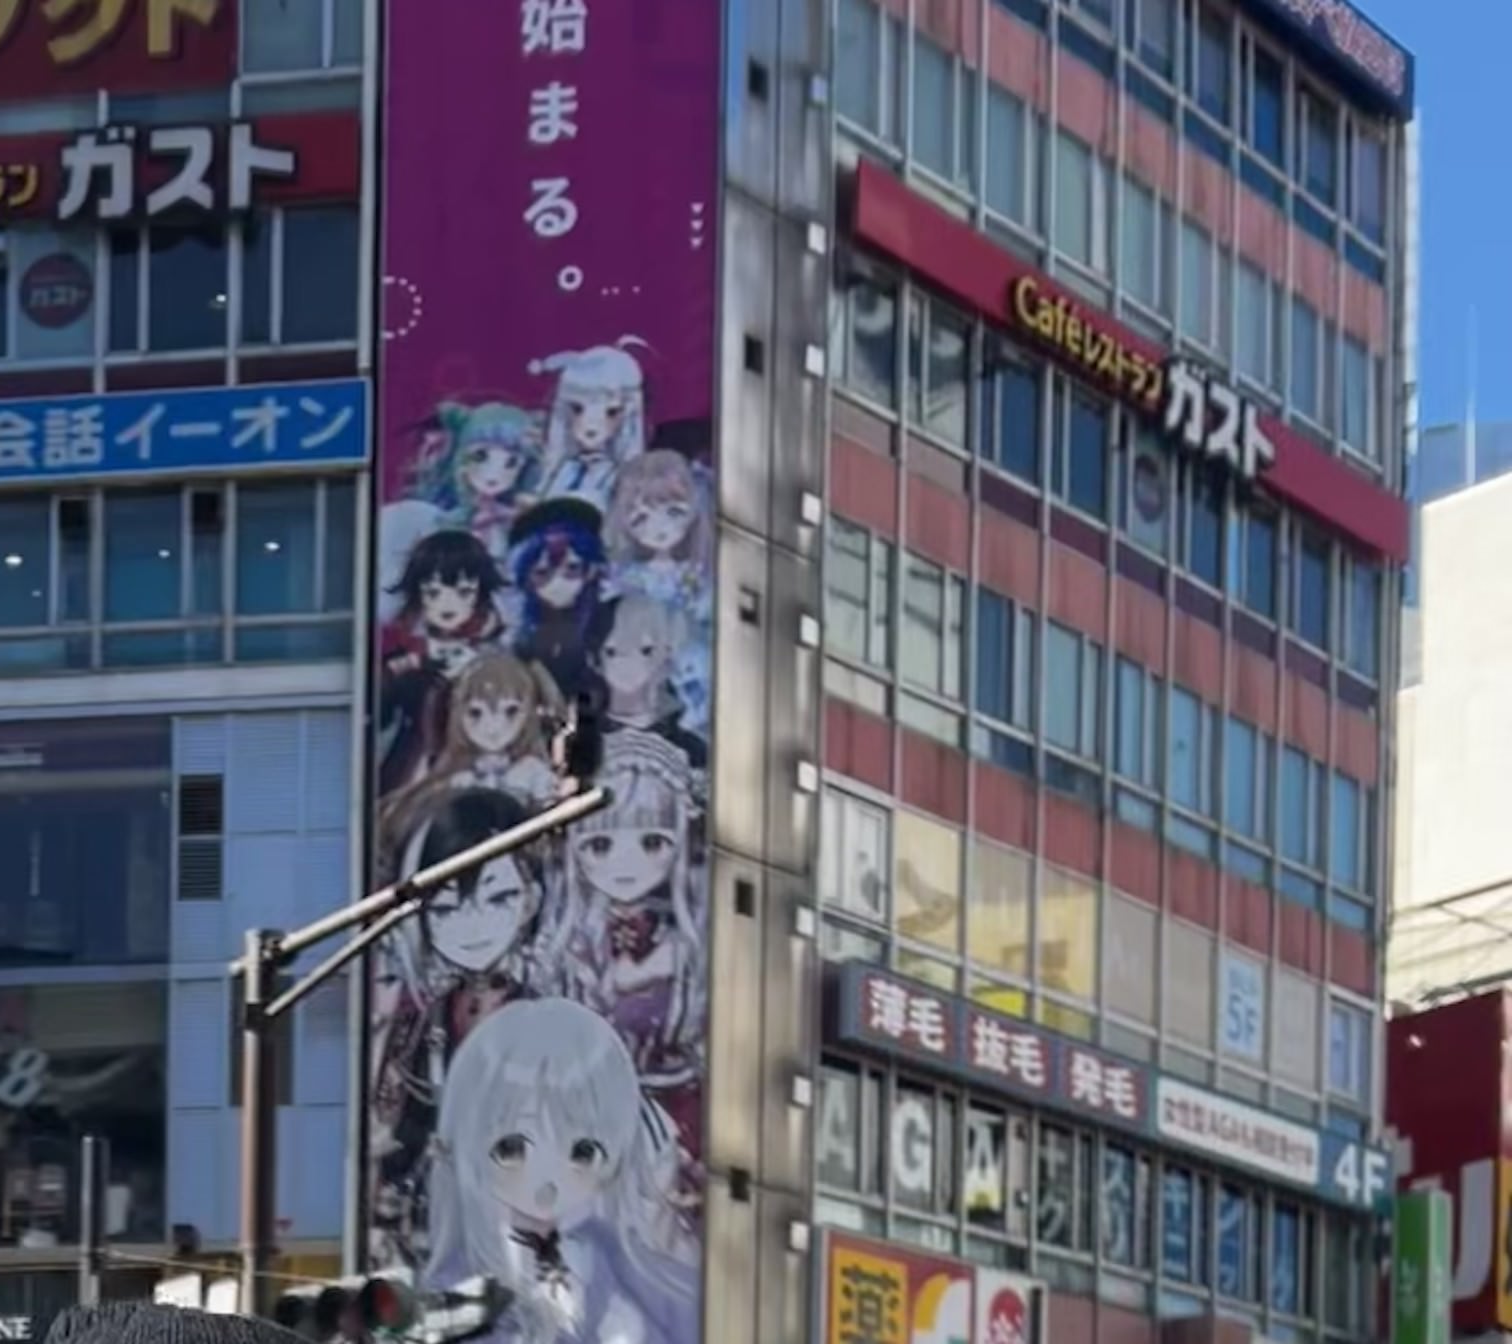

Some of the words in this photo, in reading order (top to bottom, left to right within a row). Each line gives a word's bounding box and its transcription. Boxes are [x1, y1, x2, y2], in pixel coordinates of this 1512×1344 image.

[58, 124, 294, 219] ガスト
[1165, 362, 1275, 478] ガスト
[1335, 1143, 1385, 1205] 4F
